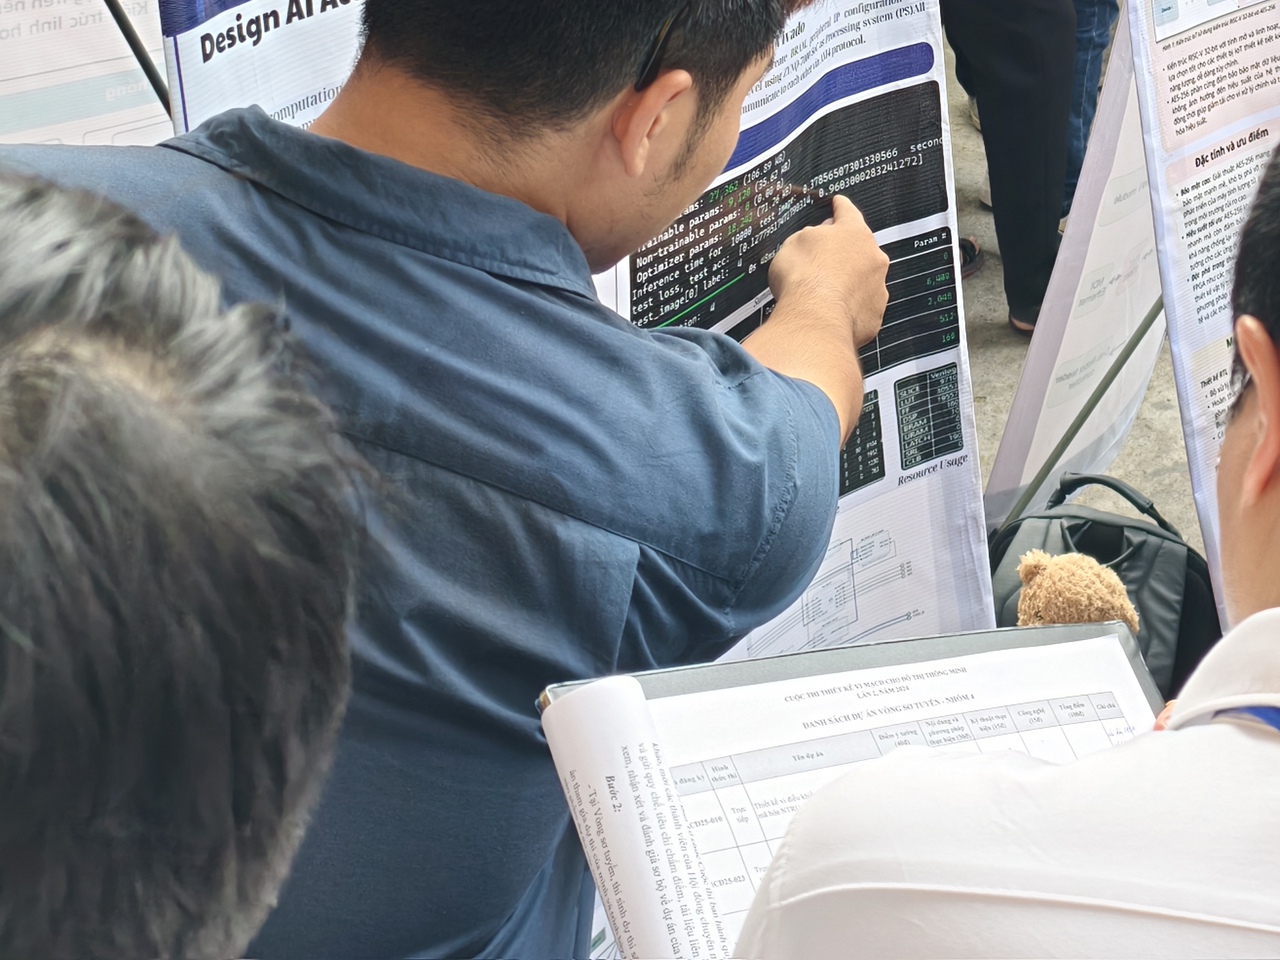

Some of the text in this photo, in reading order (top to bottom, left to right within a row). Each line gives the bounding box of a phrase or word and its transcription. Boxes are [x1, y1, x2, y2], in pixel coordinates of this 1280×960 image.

[200, 8, 280, 65] Design
[862, 11, 894, 28] system
[831, 34, 866, 56] protocol.
[1195, 127, 1269, 168] Đặc tính và ưu điểm
[636, 208, 742, 268] Non-trainable params:
[914, 235, 939, 249] Param
[632, 226, 753, 301] Inference time for 10000
[703, 269, 729, 290] label:
[632, 299, 654, 315] test
[659, 284, 684, 301] loss,
[689, 269, 708, 285] test
[712, 256, 730, 272] acc:
[897, 452, 969, 487] Resource Usage
[605, 774, 623, 813] Bước 2:
